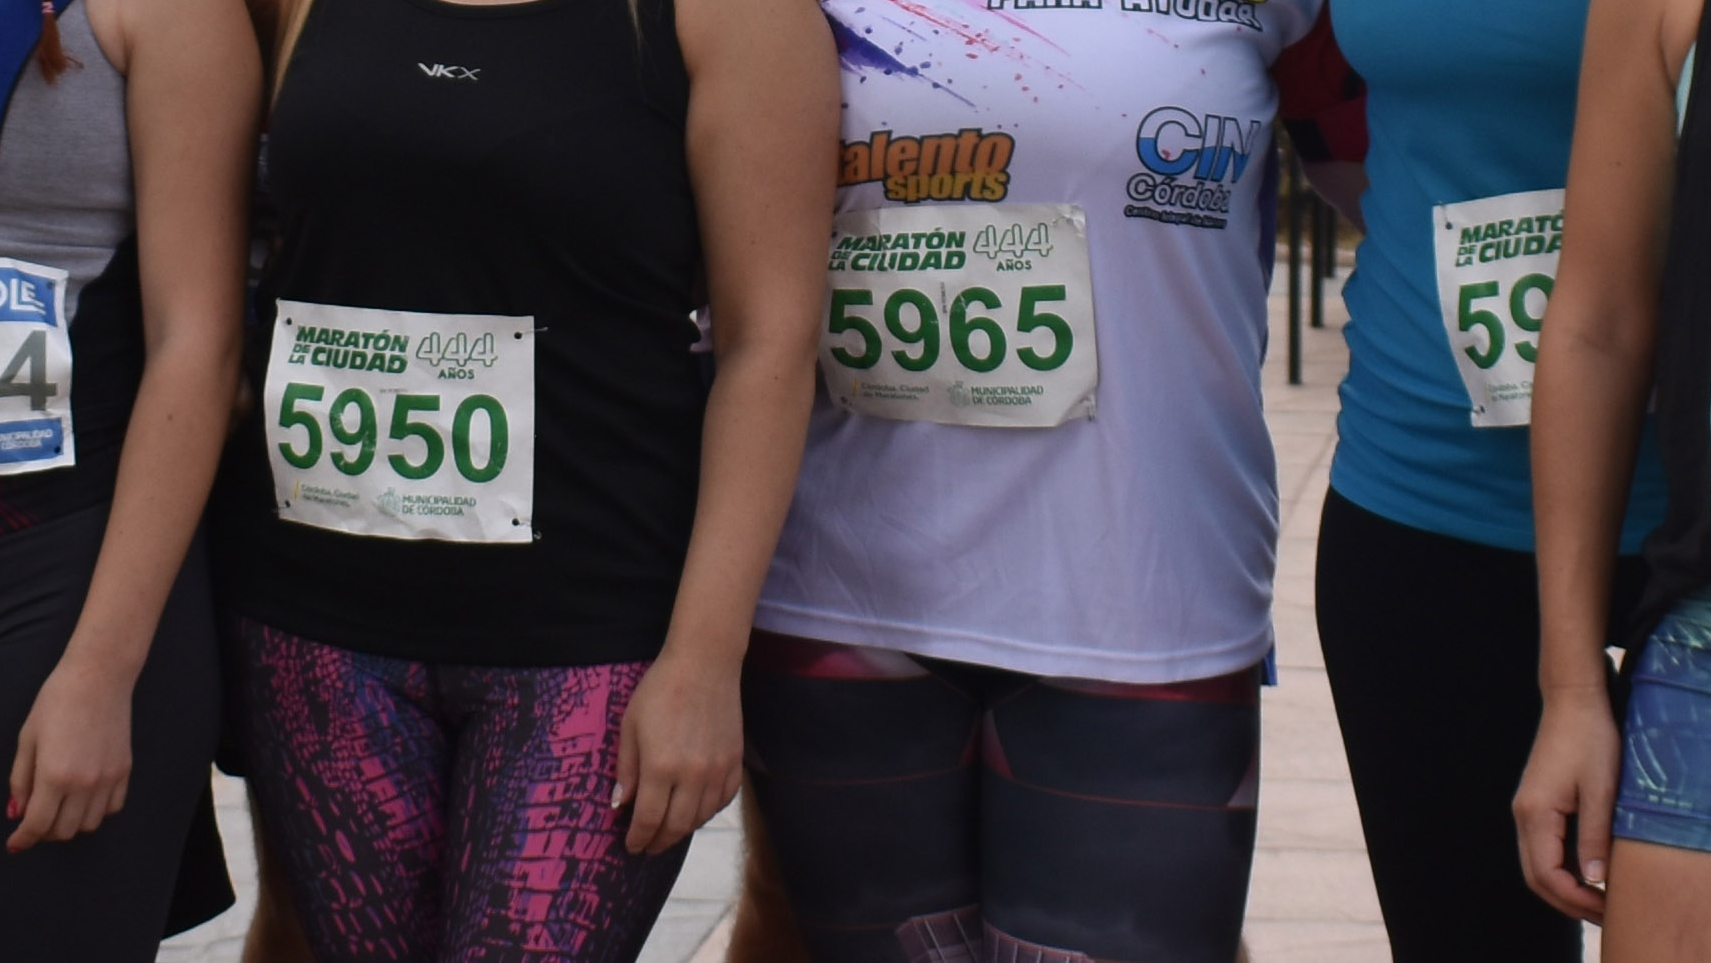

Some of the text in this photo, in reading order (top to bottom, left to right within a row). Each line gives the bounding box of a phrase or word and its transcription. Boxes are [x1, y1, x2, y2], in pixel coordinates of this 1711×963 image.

[1135, 105, 1262, 184] CIN
[883, 170, 1011, 205] sports
[838, 226, 966, 252] MARATÓN
[973, 222, 1053, 259] 444
[1457, 244, 1477, 256] DE
[850, 251, 967, 272] CIUDAD
[995, 259, 1033, 272] AÑOS
[1455, 255, 1474, 267] LA
[295, 324, 410, 353] MARATÓN
[828, 284, 1074, 373] 5965
[292, 343, 311, 354] DE
[310, 346, 409, 374] CIUDAD
[415, 332, 499, 368] 444
[437, 366, 475, 380] AÑOS
[278, 381, 509, 484] 5950
[401, 494, 477, 508] MUNICIPALIDAD
